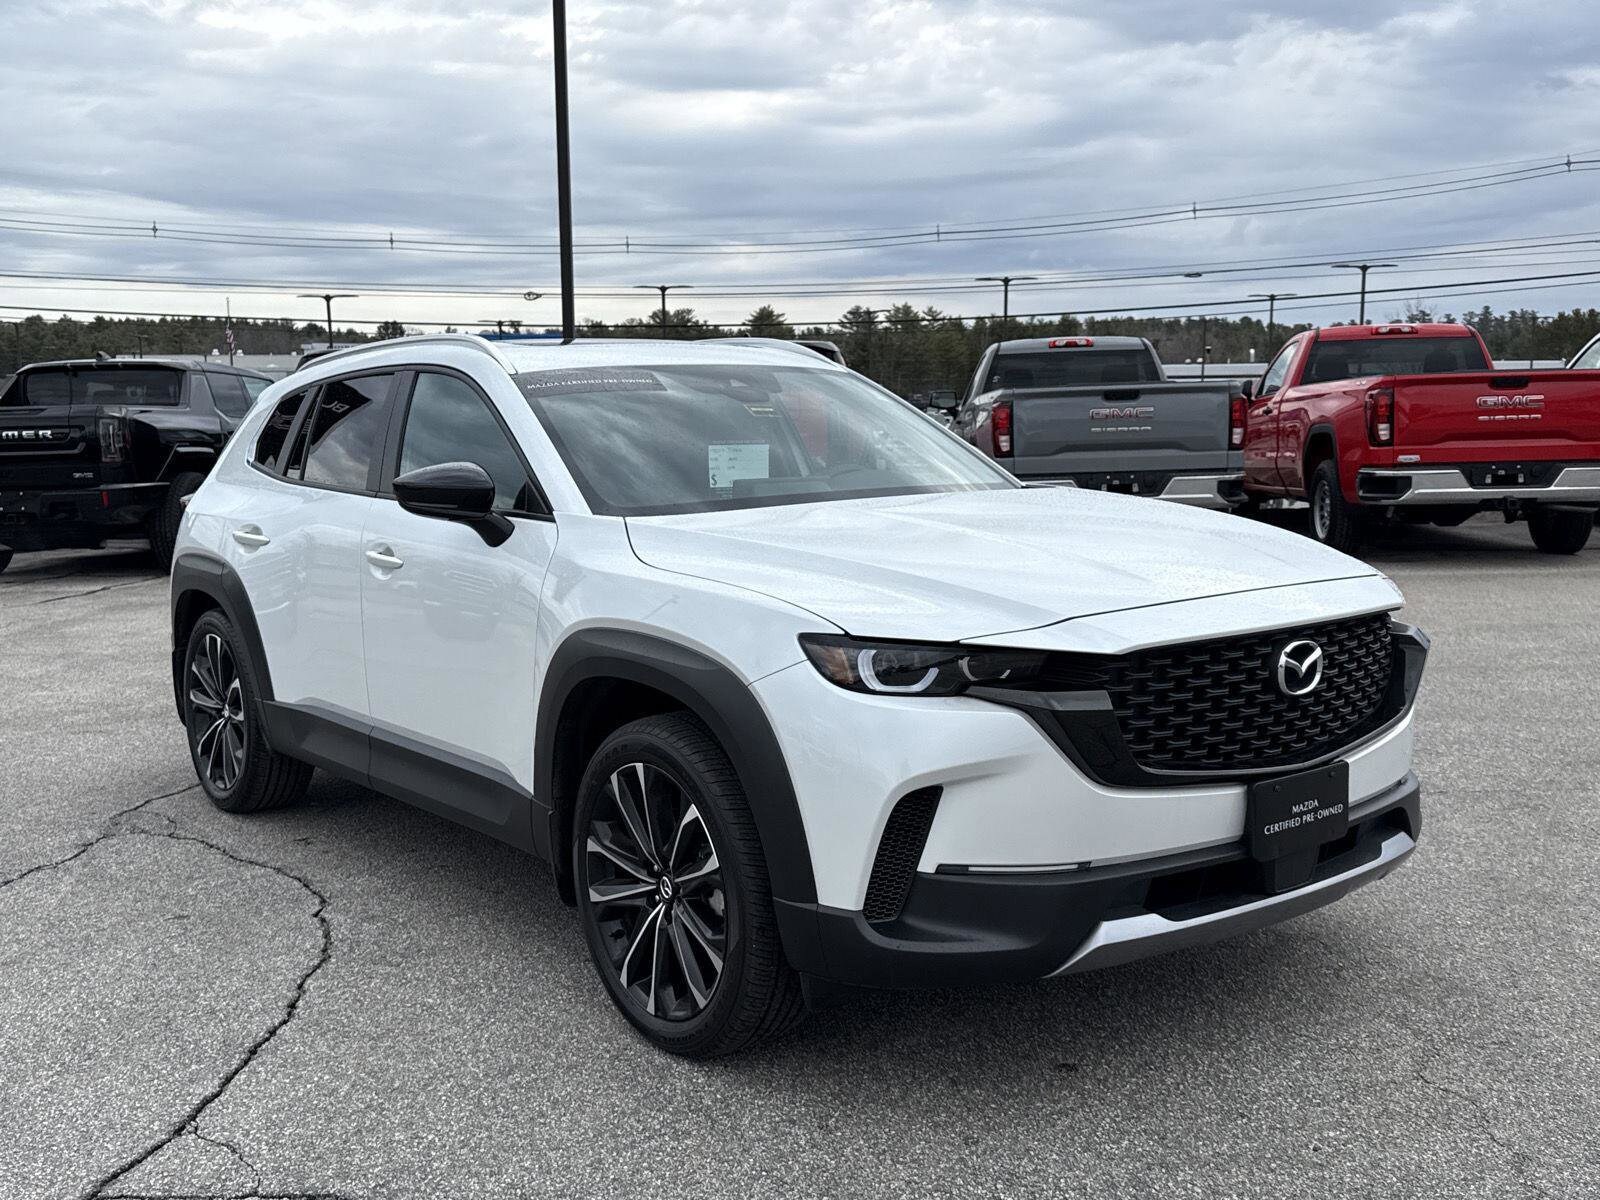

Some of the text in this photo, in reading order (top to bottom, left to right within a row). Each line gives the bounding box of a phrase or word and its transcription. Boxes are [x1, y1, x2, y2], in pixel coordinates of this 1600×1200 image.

[1476, 395, 1545, 409] GMC
[1089, 406, 1154, 420] GMC
[1291, 798, 1319, 814] MAZDA
[1264, 803, 1344, 835] CERTIFIED PRE-OWNED
